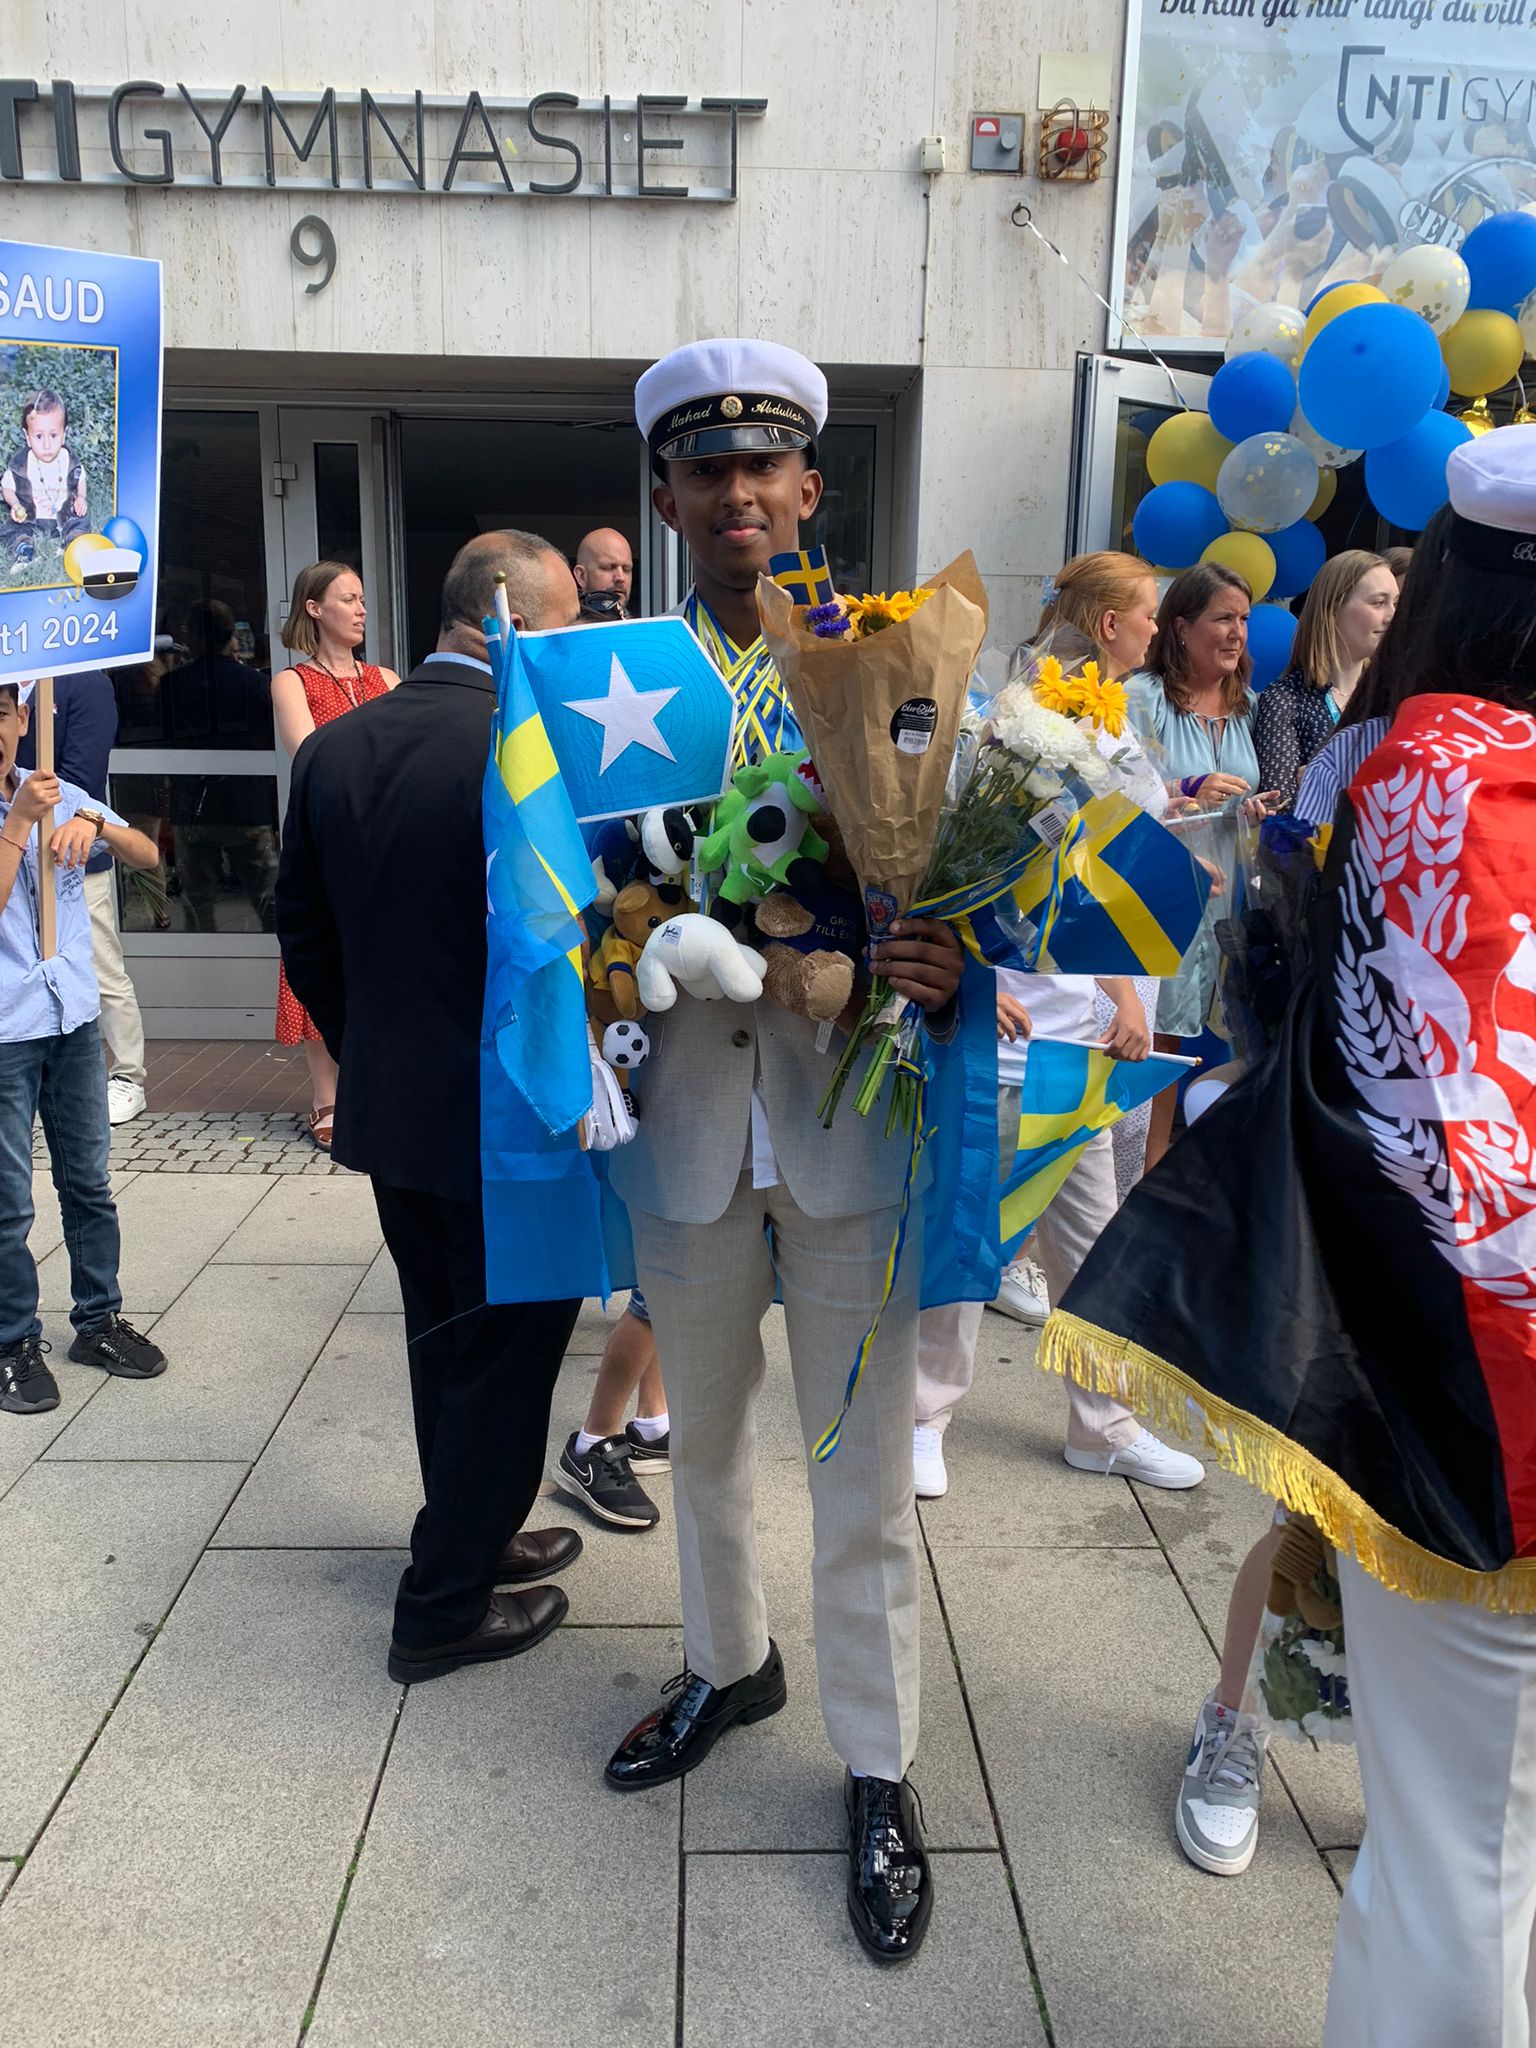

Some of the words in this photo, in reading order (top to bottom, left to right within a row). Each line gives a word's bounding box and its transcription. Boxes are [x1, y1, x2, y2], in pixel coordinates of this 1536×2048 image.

[290, 214, 337, 294] 9
[42, 609, 119, 650] 2024
[815, 924, 837, 937] TILL
